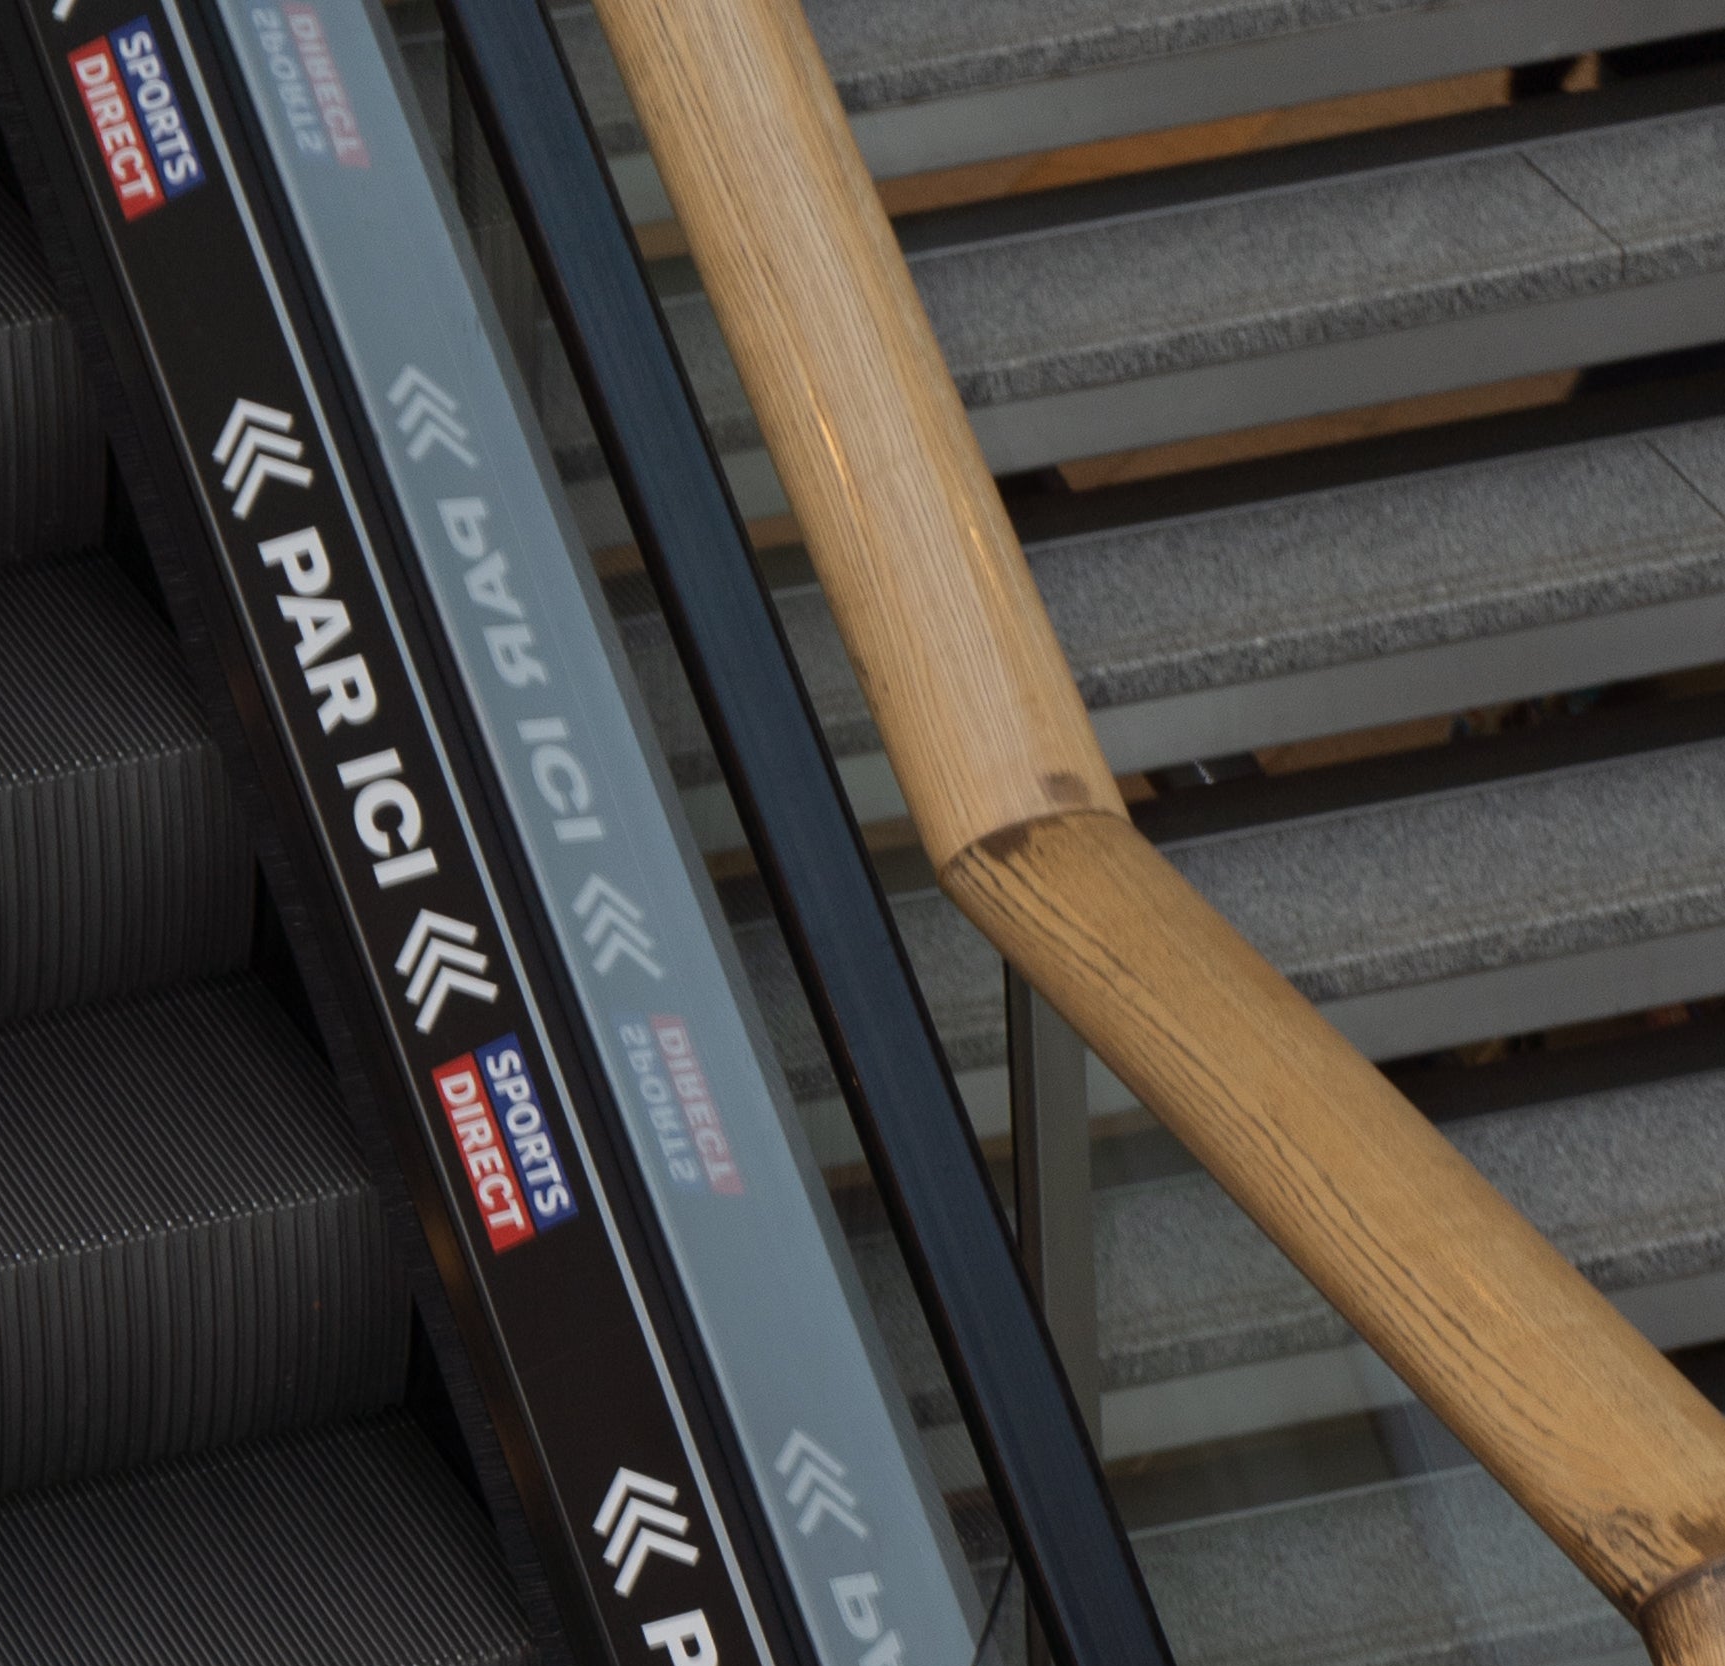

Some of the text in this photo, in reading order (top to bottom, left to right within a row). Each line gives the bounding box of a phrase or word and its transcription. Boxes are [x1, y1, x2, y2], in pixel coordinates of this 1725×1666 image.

[76, 52, 155, 200] DIRECT
[119, 30, 198, 185] SPORTS
[257, 526, 438, 889] PAR ICI
[440, 1071, 527, 1233] DIRECT
[487, 1047, 570, 1218] SPORTS
